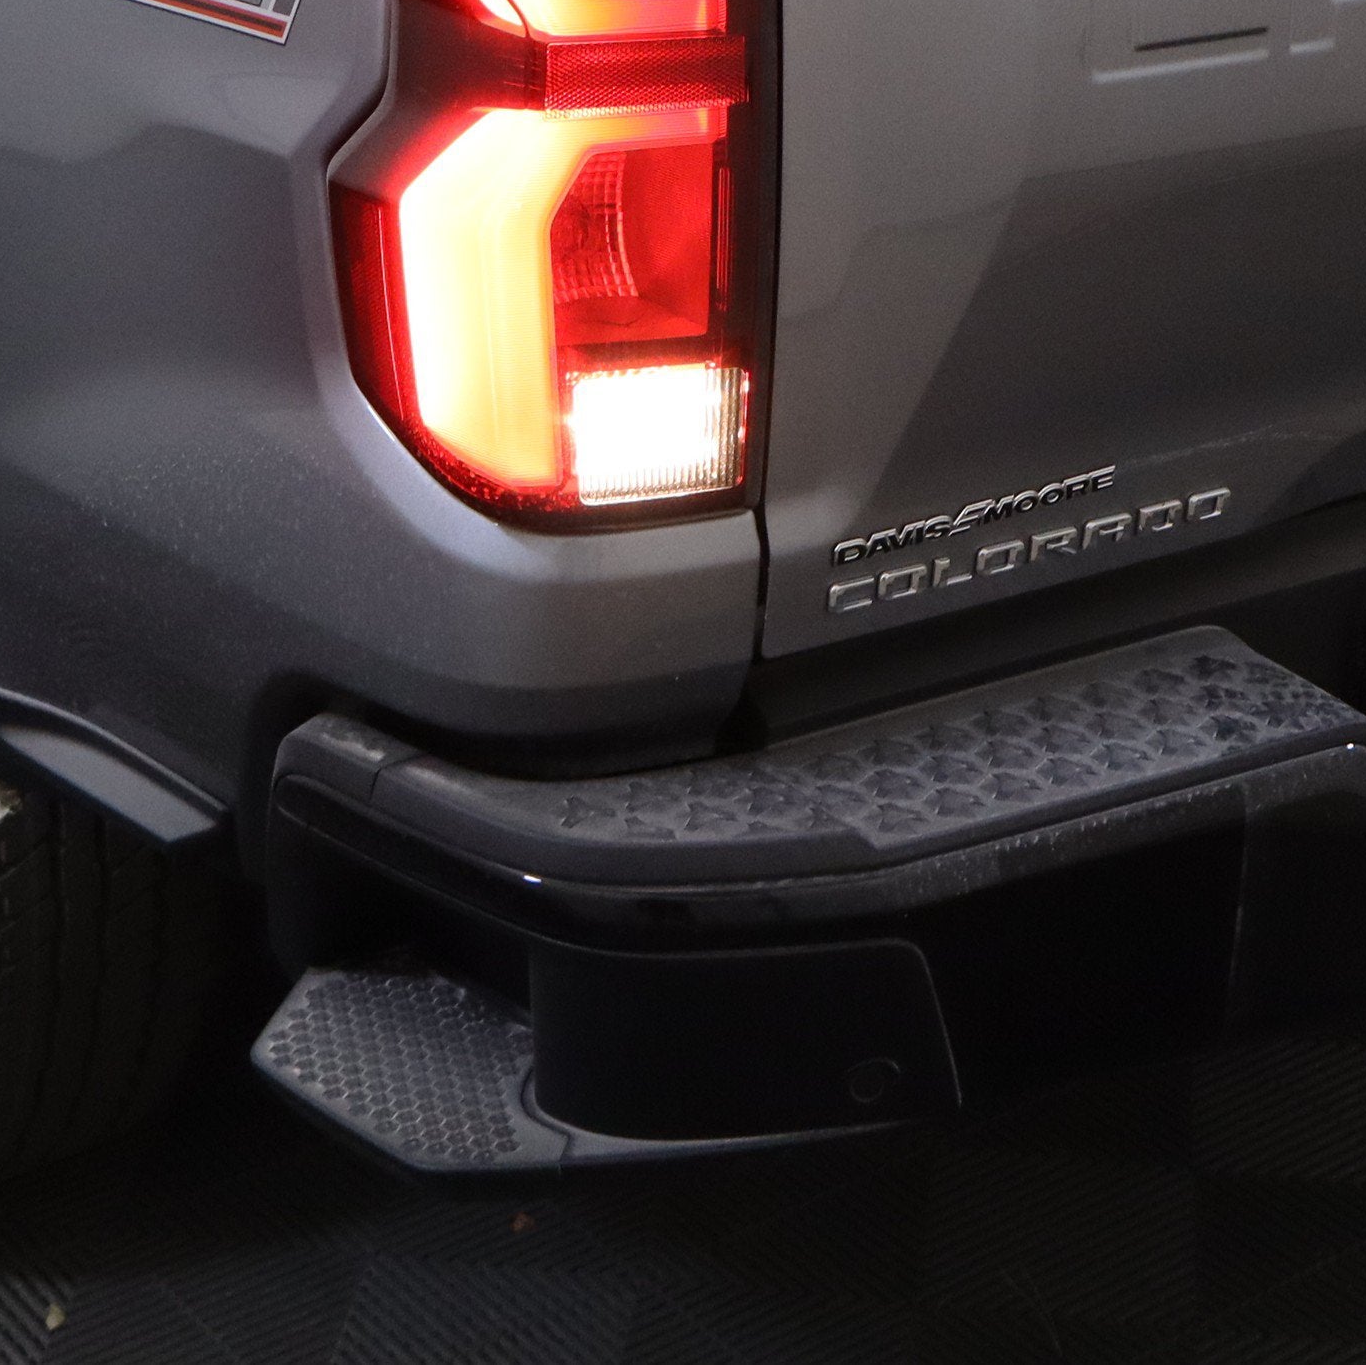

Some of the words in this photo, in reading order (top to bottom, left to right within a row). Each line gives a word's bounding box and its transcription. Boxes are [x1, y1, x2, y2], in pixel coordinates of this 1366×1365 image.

[826, 486, 1232, 614] COLORADO
[831, 514, 955, 567] DAVIS
[981, 464, 1117, 525] MOORE
